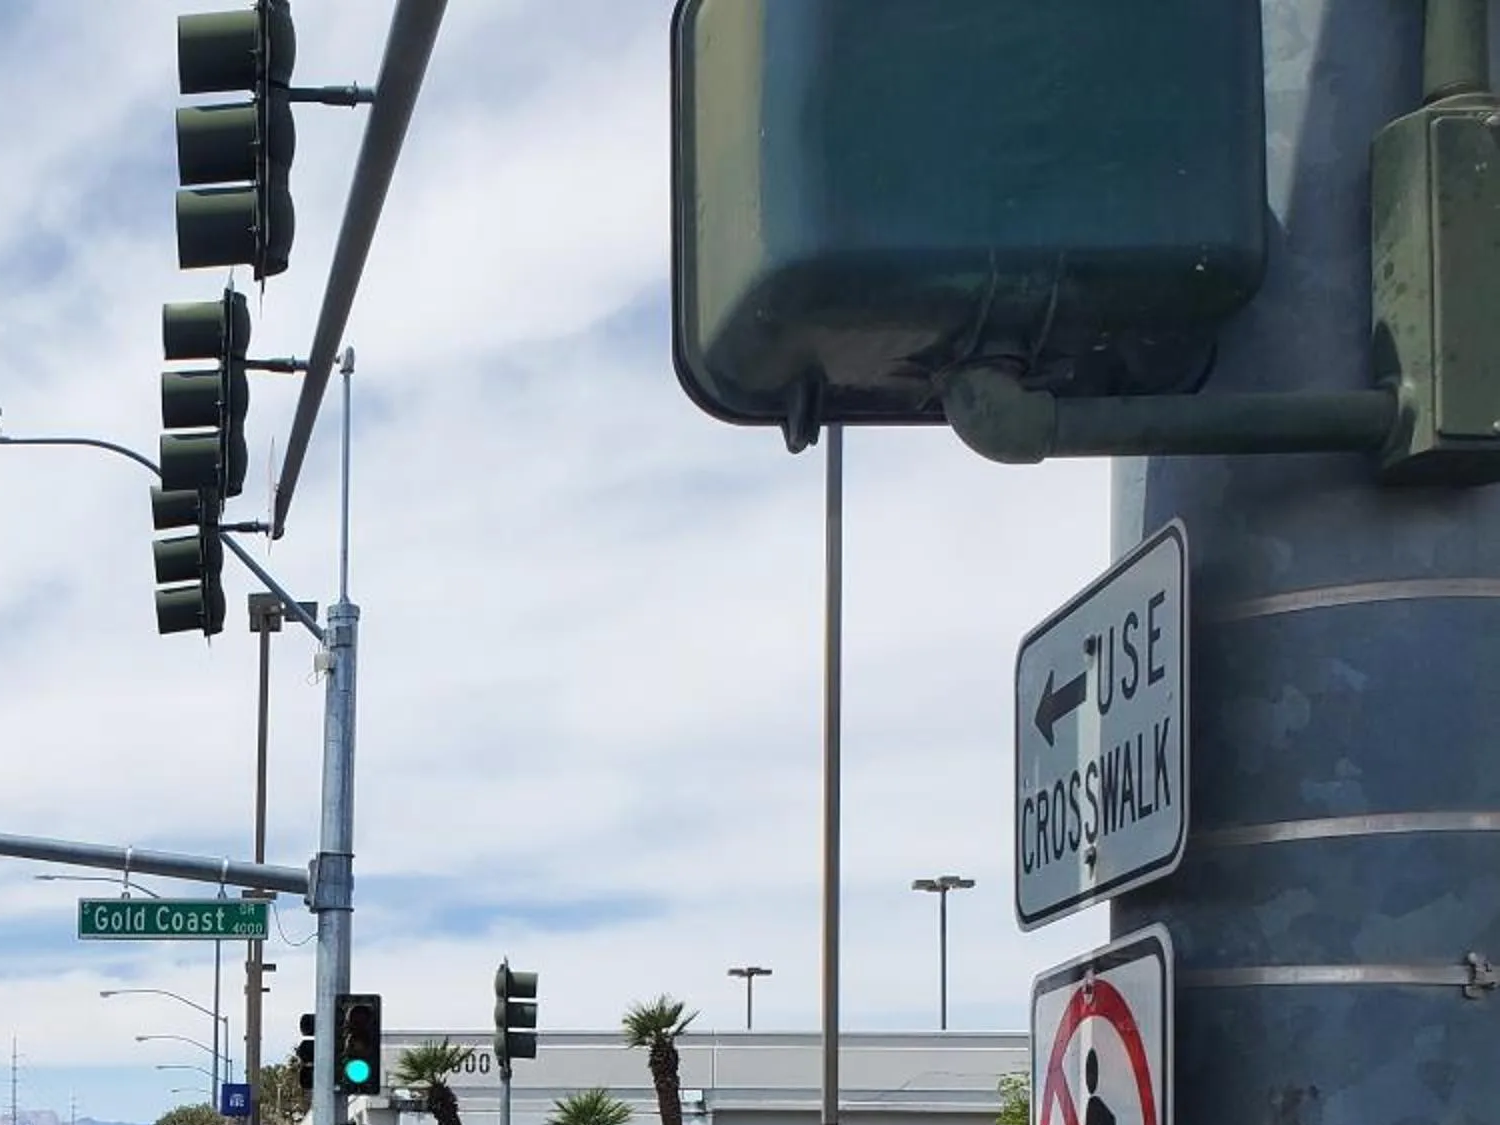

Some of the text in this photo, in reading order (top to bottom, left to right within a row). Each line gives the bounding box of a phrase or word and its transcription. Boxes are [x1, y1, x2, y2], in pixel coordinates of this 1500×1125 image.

[1095, 590, 1167, 716] USE
[1021, 717, 1172, 874] CROSSWALK
[94, 906, 146, 931] Gold
[156, 906, 226, 932] Coast
[232, 922, 263, 935] 4000
